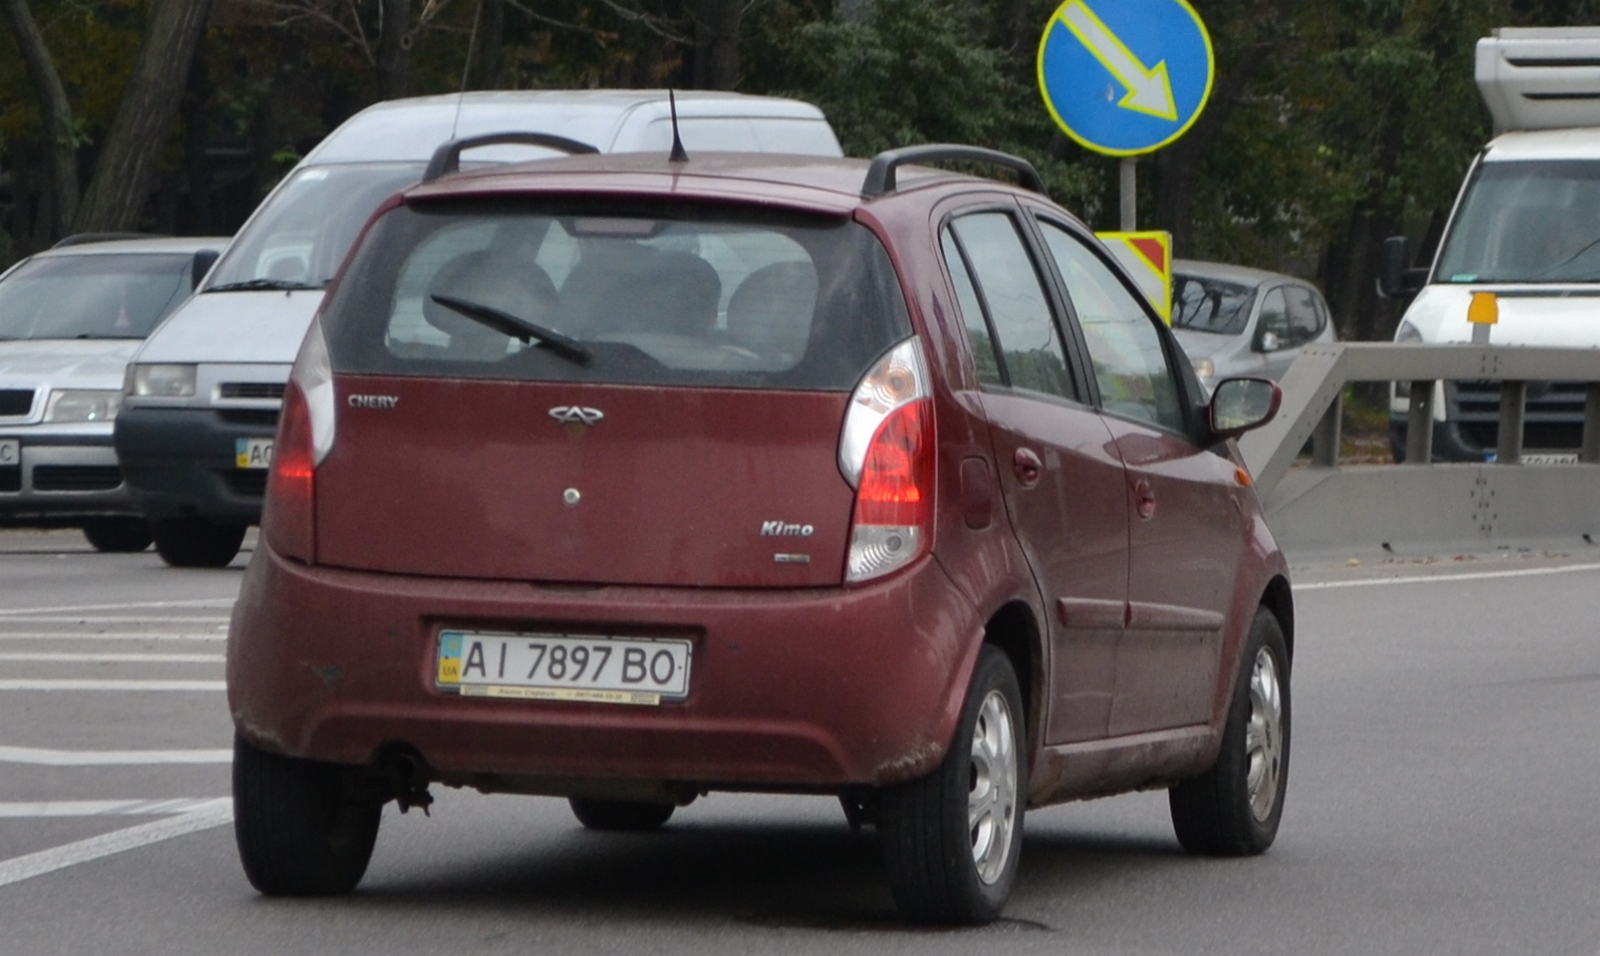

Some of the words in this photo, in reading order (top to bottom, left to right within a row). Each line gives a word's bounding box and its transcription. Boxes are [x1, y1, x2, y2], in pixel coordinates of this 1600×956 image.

[347, 394, 399, 409] CHERY
[760, 520, 814, 537] Kimo
[462, 641, 507, 678] AI
[527, 643, 612, 682] 7897
[621, 647, 675, 685] BO
[443, 666, 458, 677] UA
